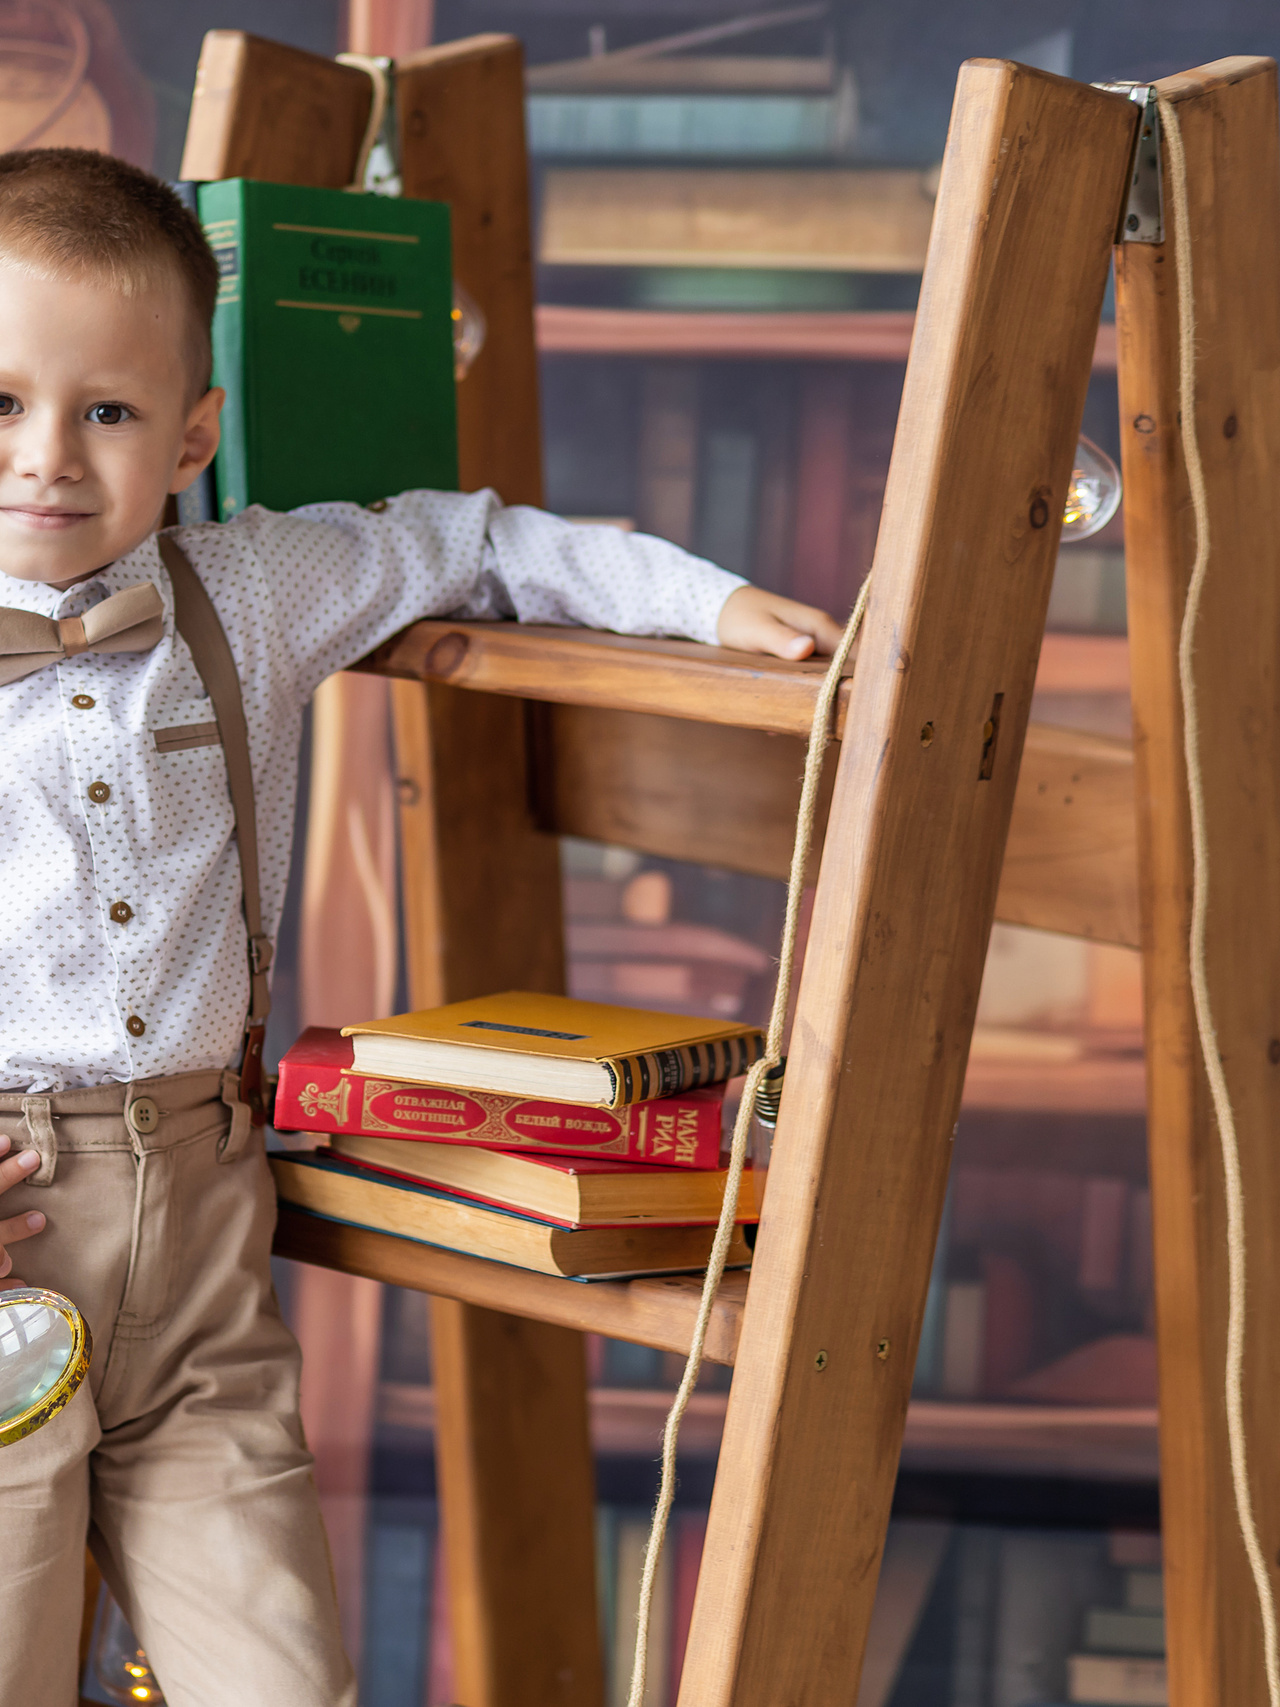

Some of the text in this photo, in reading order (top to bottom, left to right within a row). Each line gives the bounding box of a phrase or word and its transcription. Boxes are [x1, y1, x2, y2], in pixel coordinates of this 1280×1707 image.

[394, 1095, 466, 1112] ОТВАЖНАЯ
[393, 1109, 467, 1127] ОХОТНИЦА
[515, 1114, 613, 1134] БЕЛЫЙ ВОЖДЬ
[649, 1114, 675, 1157] РИД
[674, 1108, 699, 1163] МАЙН
